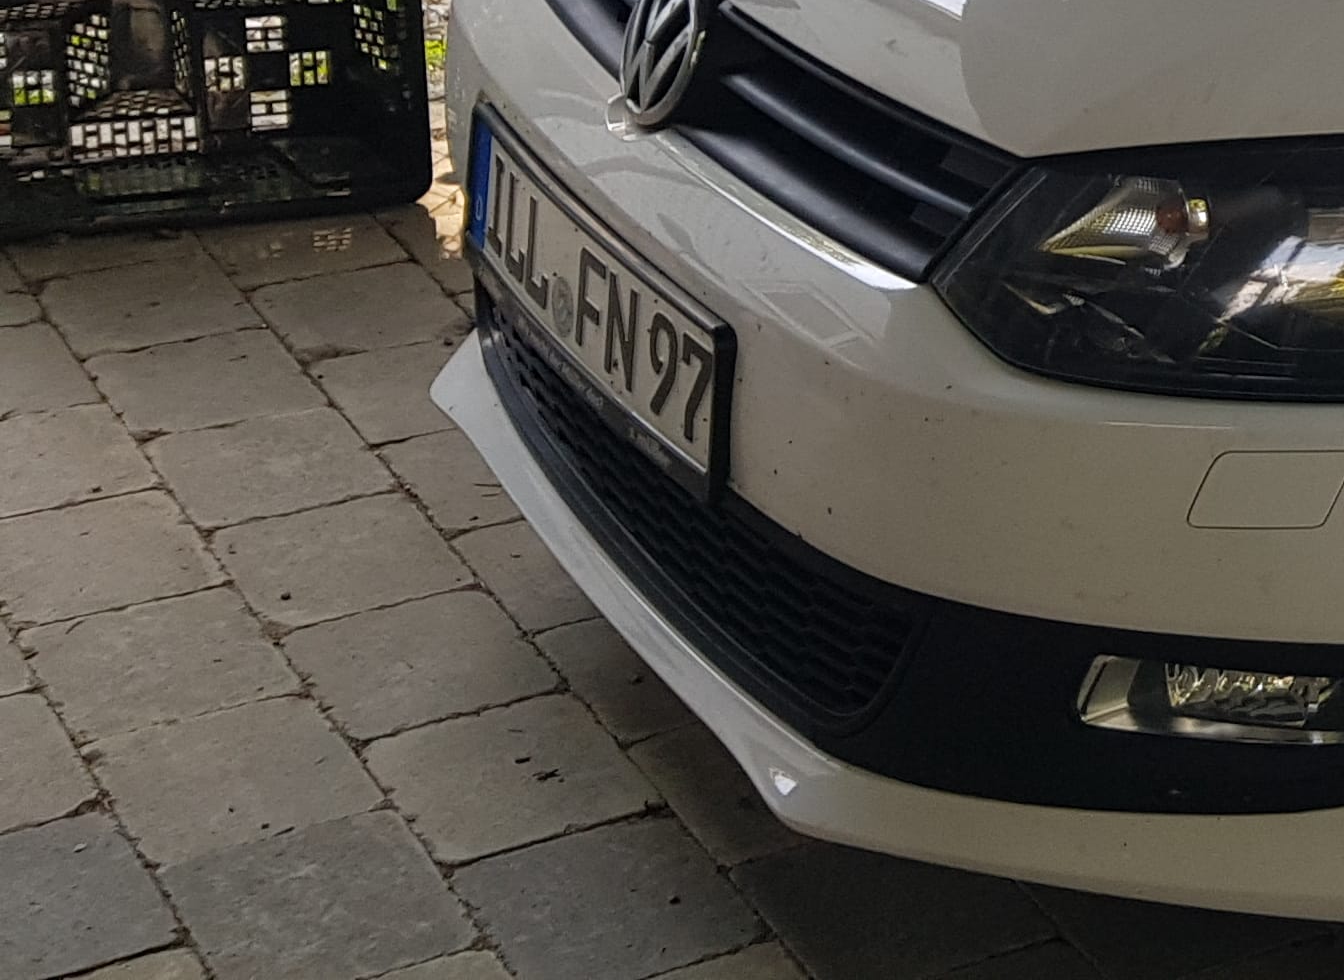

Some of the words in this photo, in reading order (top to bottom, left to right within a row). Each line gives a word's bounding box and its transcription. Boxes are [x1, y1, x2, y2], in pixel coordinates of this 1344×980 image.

[485, 153, 548, 311] ILL
[574, 246, 640, 393] FN
[649, 311, 713, 443] 97
